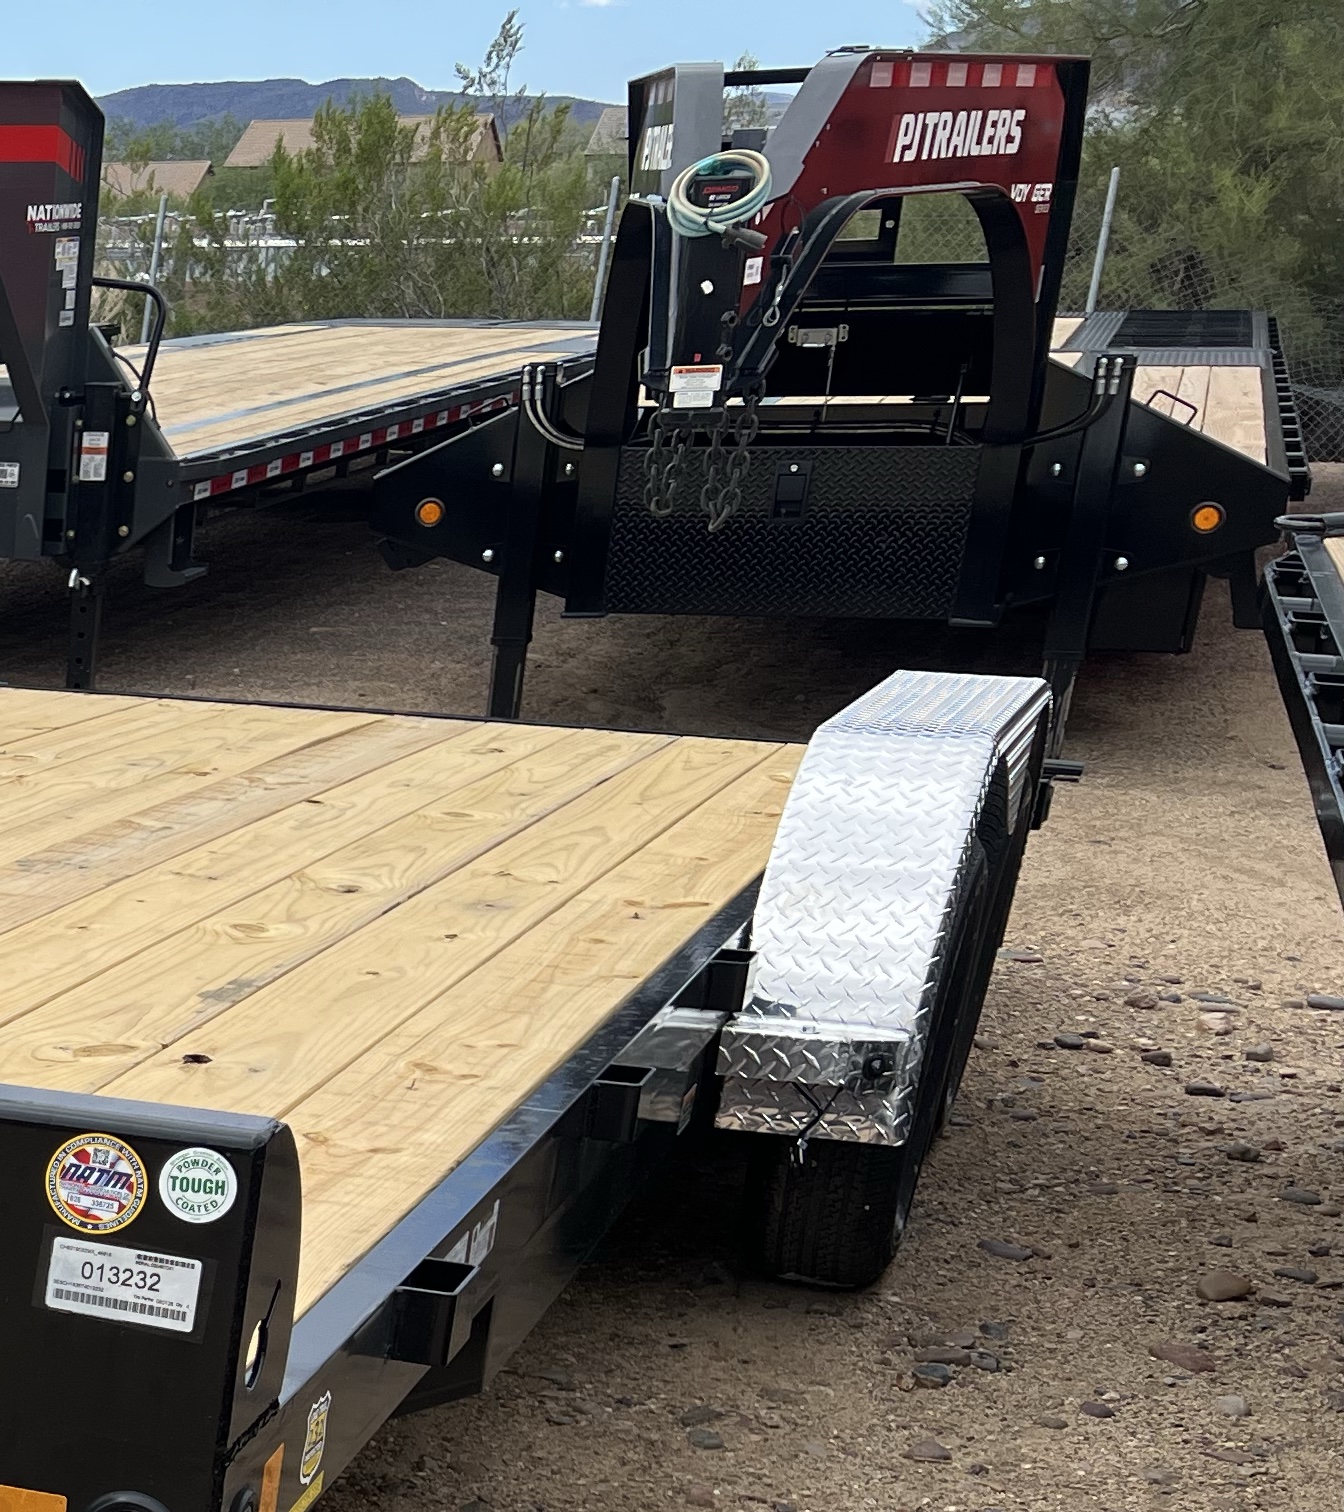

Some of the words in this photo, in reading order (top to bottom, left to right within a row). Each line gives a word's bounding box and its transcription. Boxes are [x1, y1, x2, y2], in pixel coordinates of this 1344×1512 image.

[892, 112, 925, 163] PJ
[920, 109, 1027, 161] TRAILERS
[65, 1136, 122, 1156] COMPLIANCE
[121, 1147, 140, 1172] WITH
[175, 1158, 222, 1176] POWDER
[59, 1162, 133, 1190] NATM
[169, 1175, 226, 1197] TOUGH
[175, 1197, 219, 1213] COATED
[81, 1261, 161, 1292] 013232
